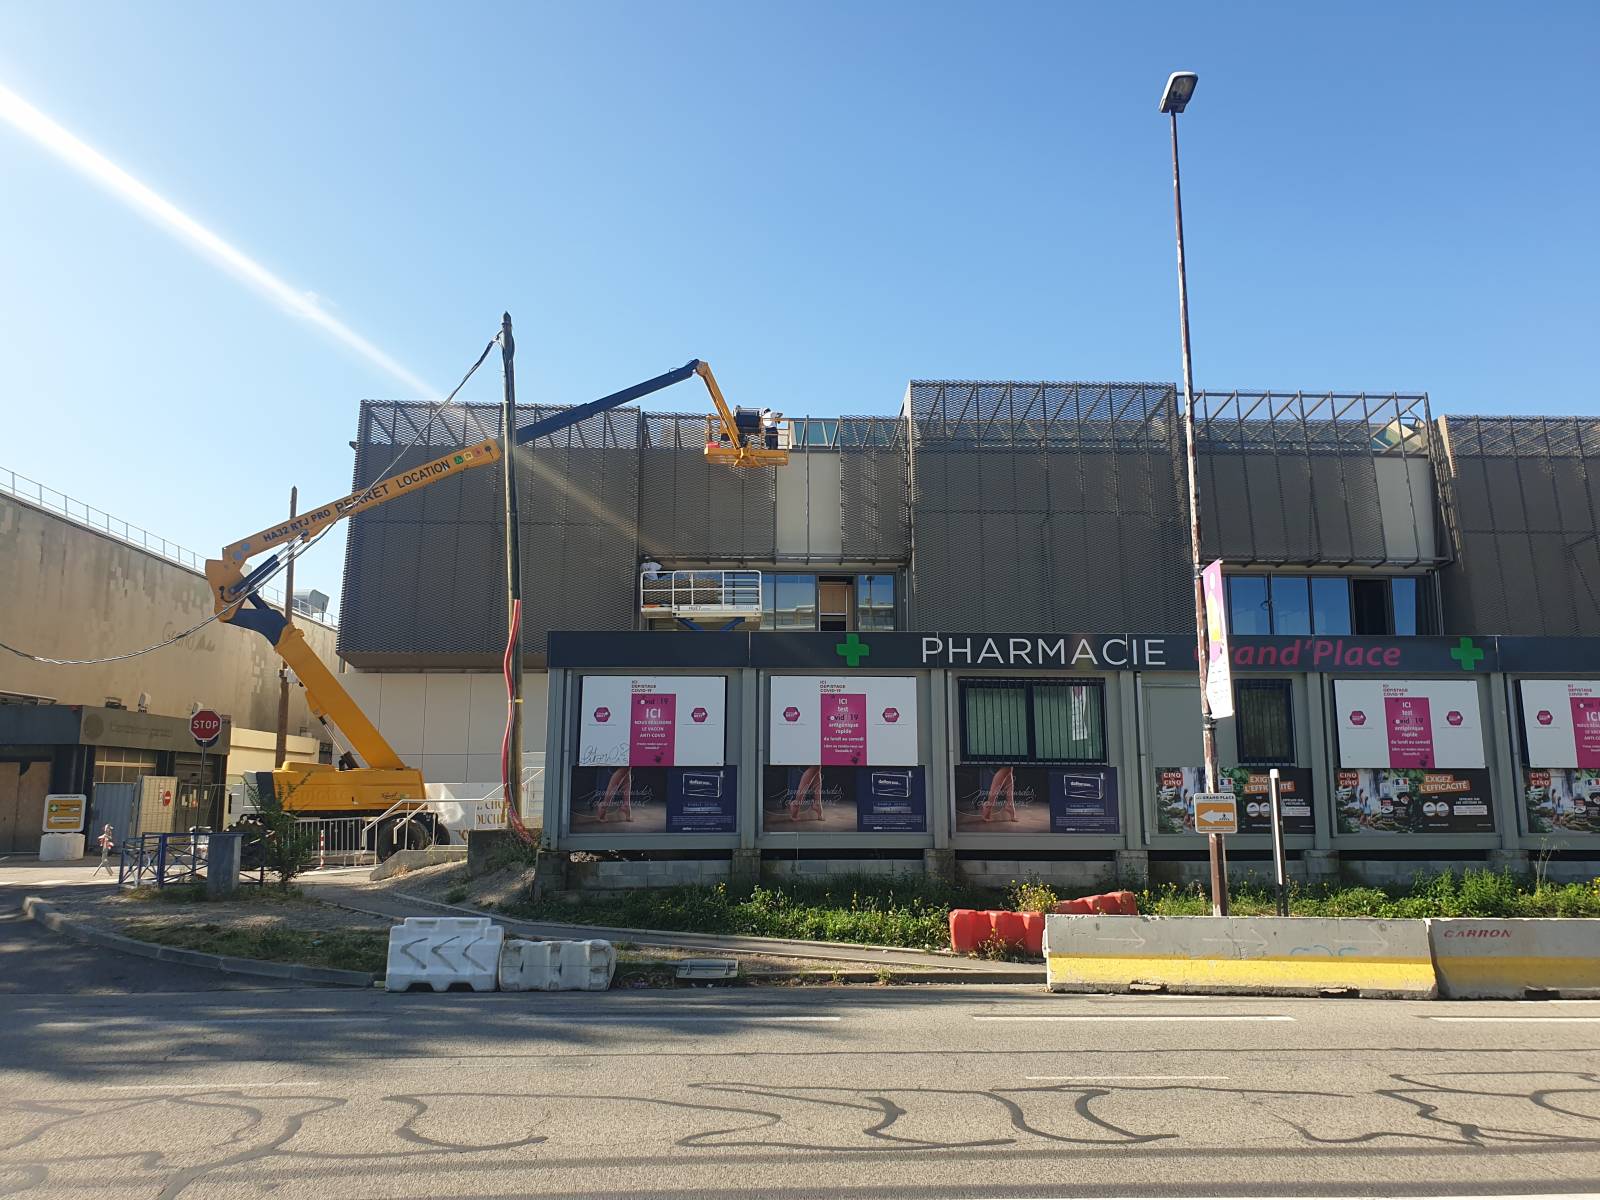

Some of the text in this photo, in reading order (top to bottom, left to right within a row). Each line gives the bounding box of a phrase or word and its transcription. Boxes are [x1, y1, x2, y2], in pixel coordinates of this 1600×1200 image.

[263, 460, 451, 542] HA32 RTJ PRO PERRET LOCATION
[922, 637, 1166, 666] PHARMACIE
[645, 708, 661, 719] ICI
[193, 720, 218, 729] STOP
[1425, 775, 1452, 783] EXIGEZ
[1420, 780, 1468, 792] L'EFFICACITÉ
[1444, 929, 1513, 938] CARRON
